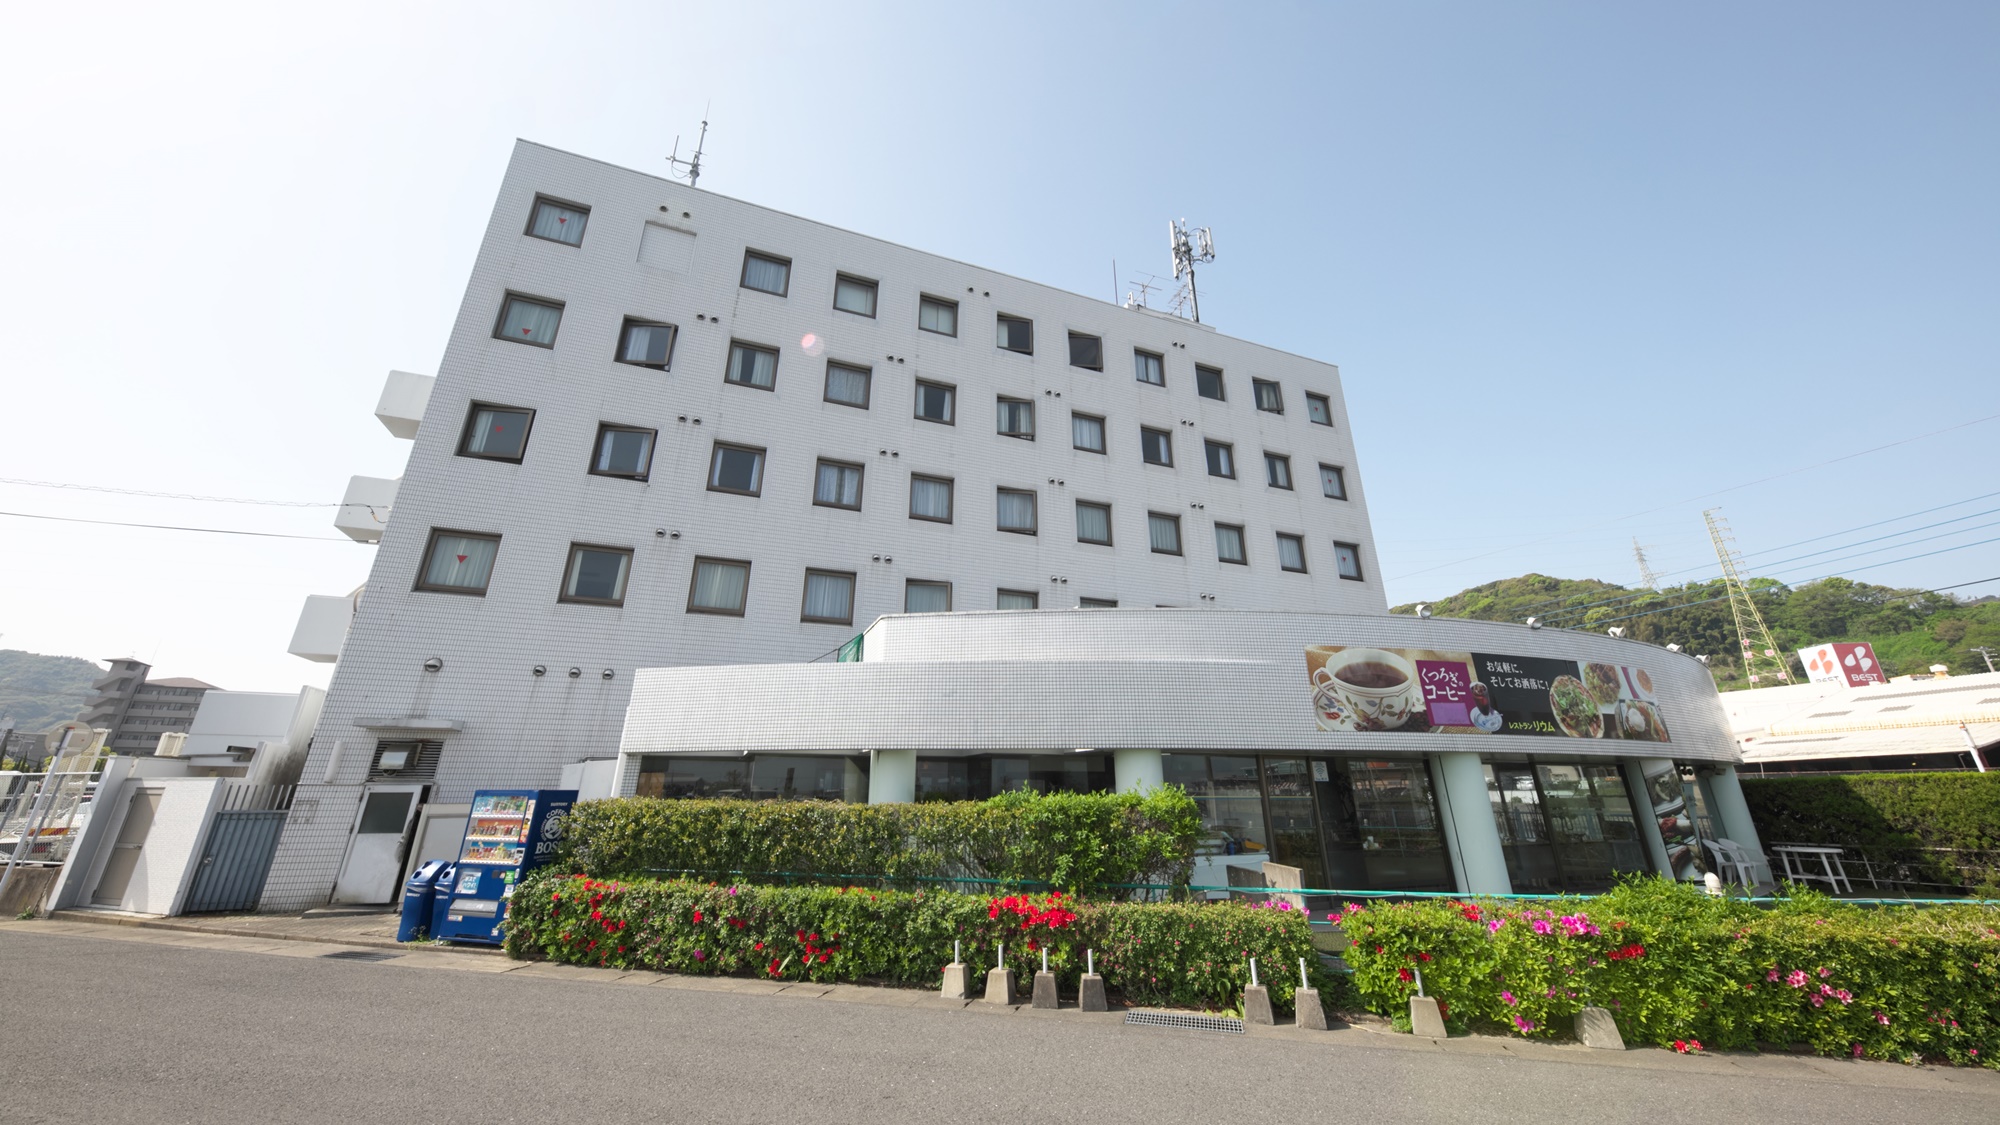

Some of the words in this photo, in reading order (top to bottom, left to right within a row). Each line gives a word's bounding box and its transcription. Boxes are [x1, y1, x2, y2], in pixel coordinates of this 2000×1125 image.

[1421, 667, 1464, 688] くつろぎの
[1851, 673, 1878, 682] BEST
[1424, 684, 1467, 701] コーヒー
